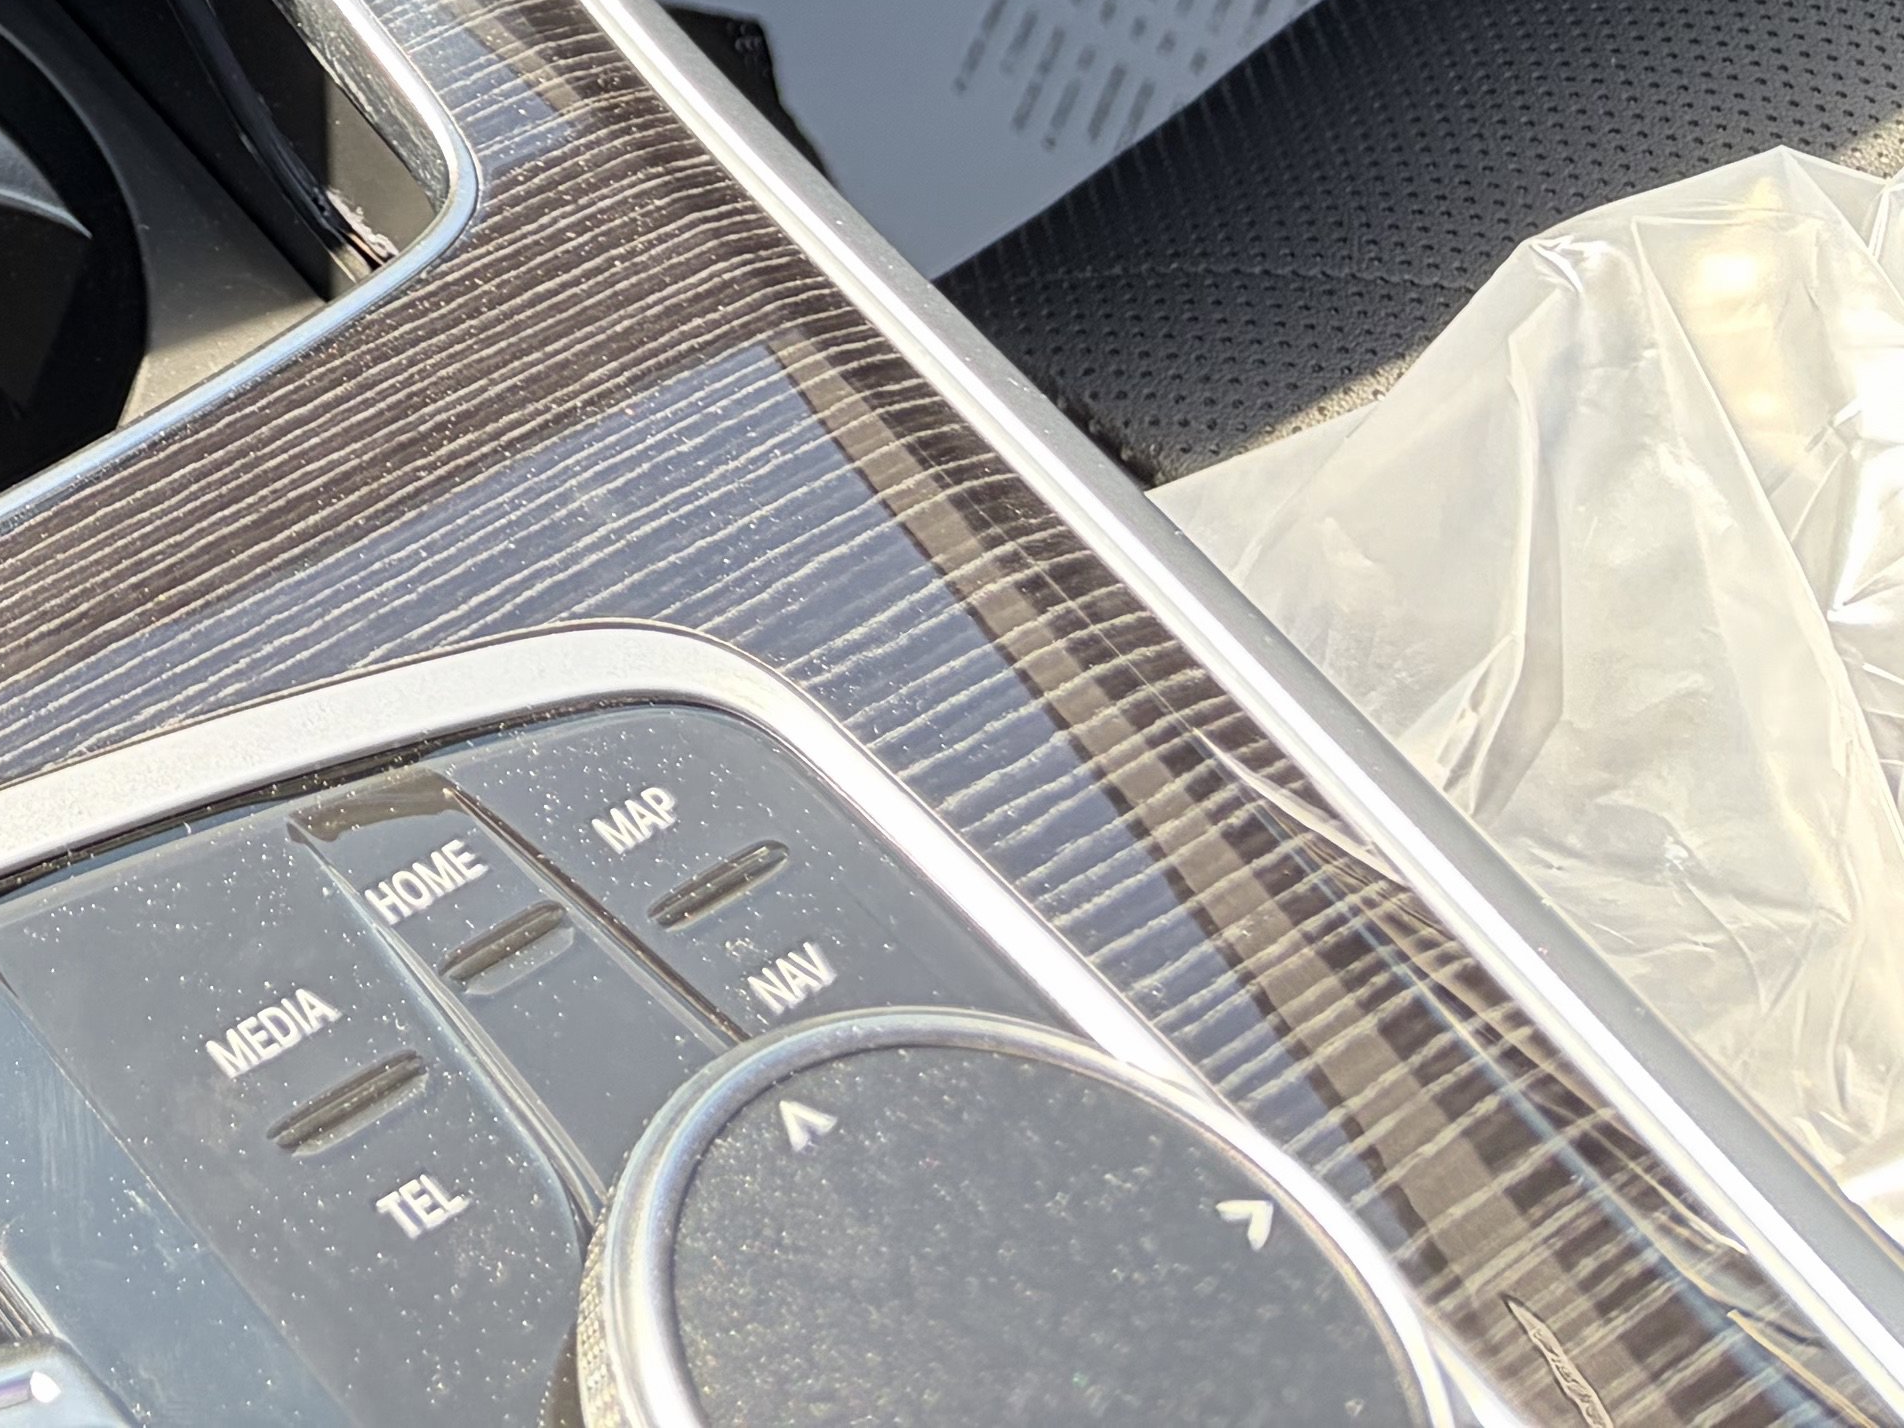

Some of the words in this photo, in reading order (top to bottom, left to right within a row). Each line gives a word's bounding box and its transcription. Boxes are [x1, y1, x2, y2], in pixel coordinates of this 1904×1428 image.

[591, 786, 679, 855] MAP
[363, 839, 490, 926] HOME
[747, 941, 839, 1015] NAV
[204, 987, 345, 1079] MEDIA
[374, 1173, 472, 1240] TEL
